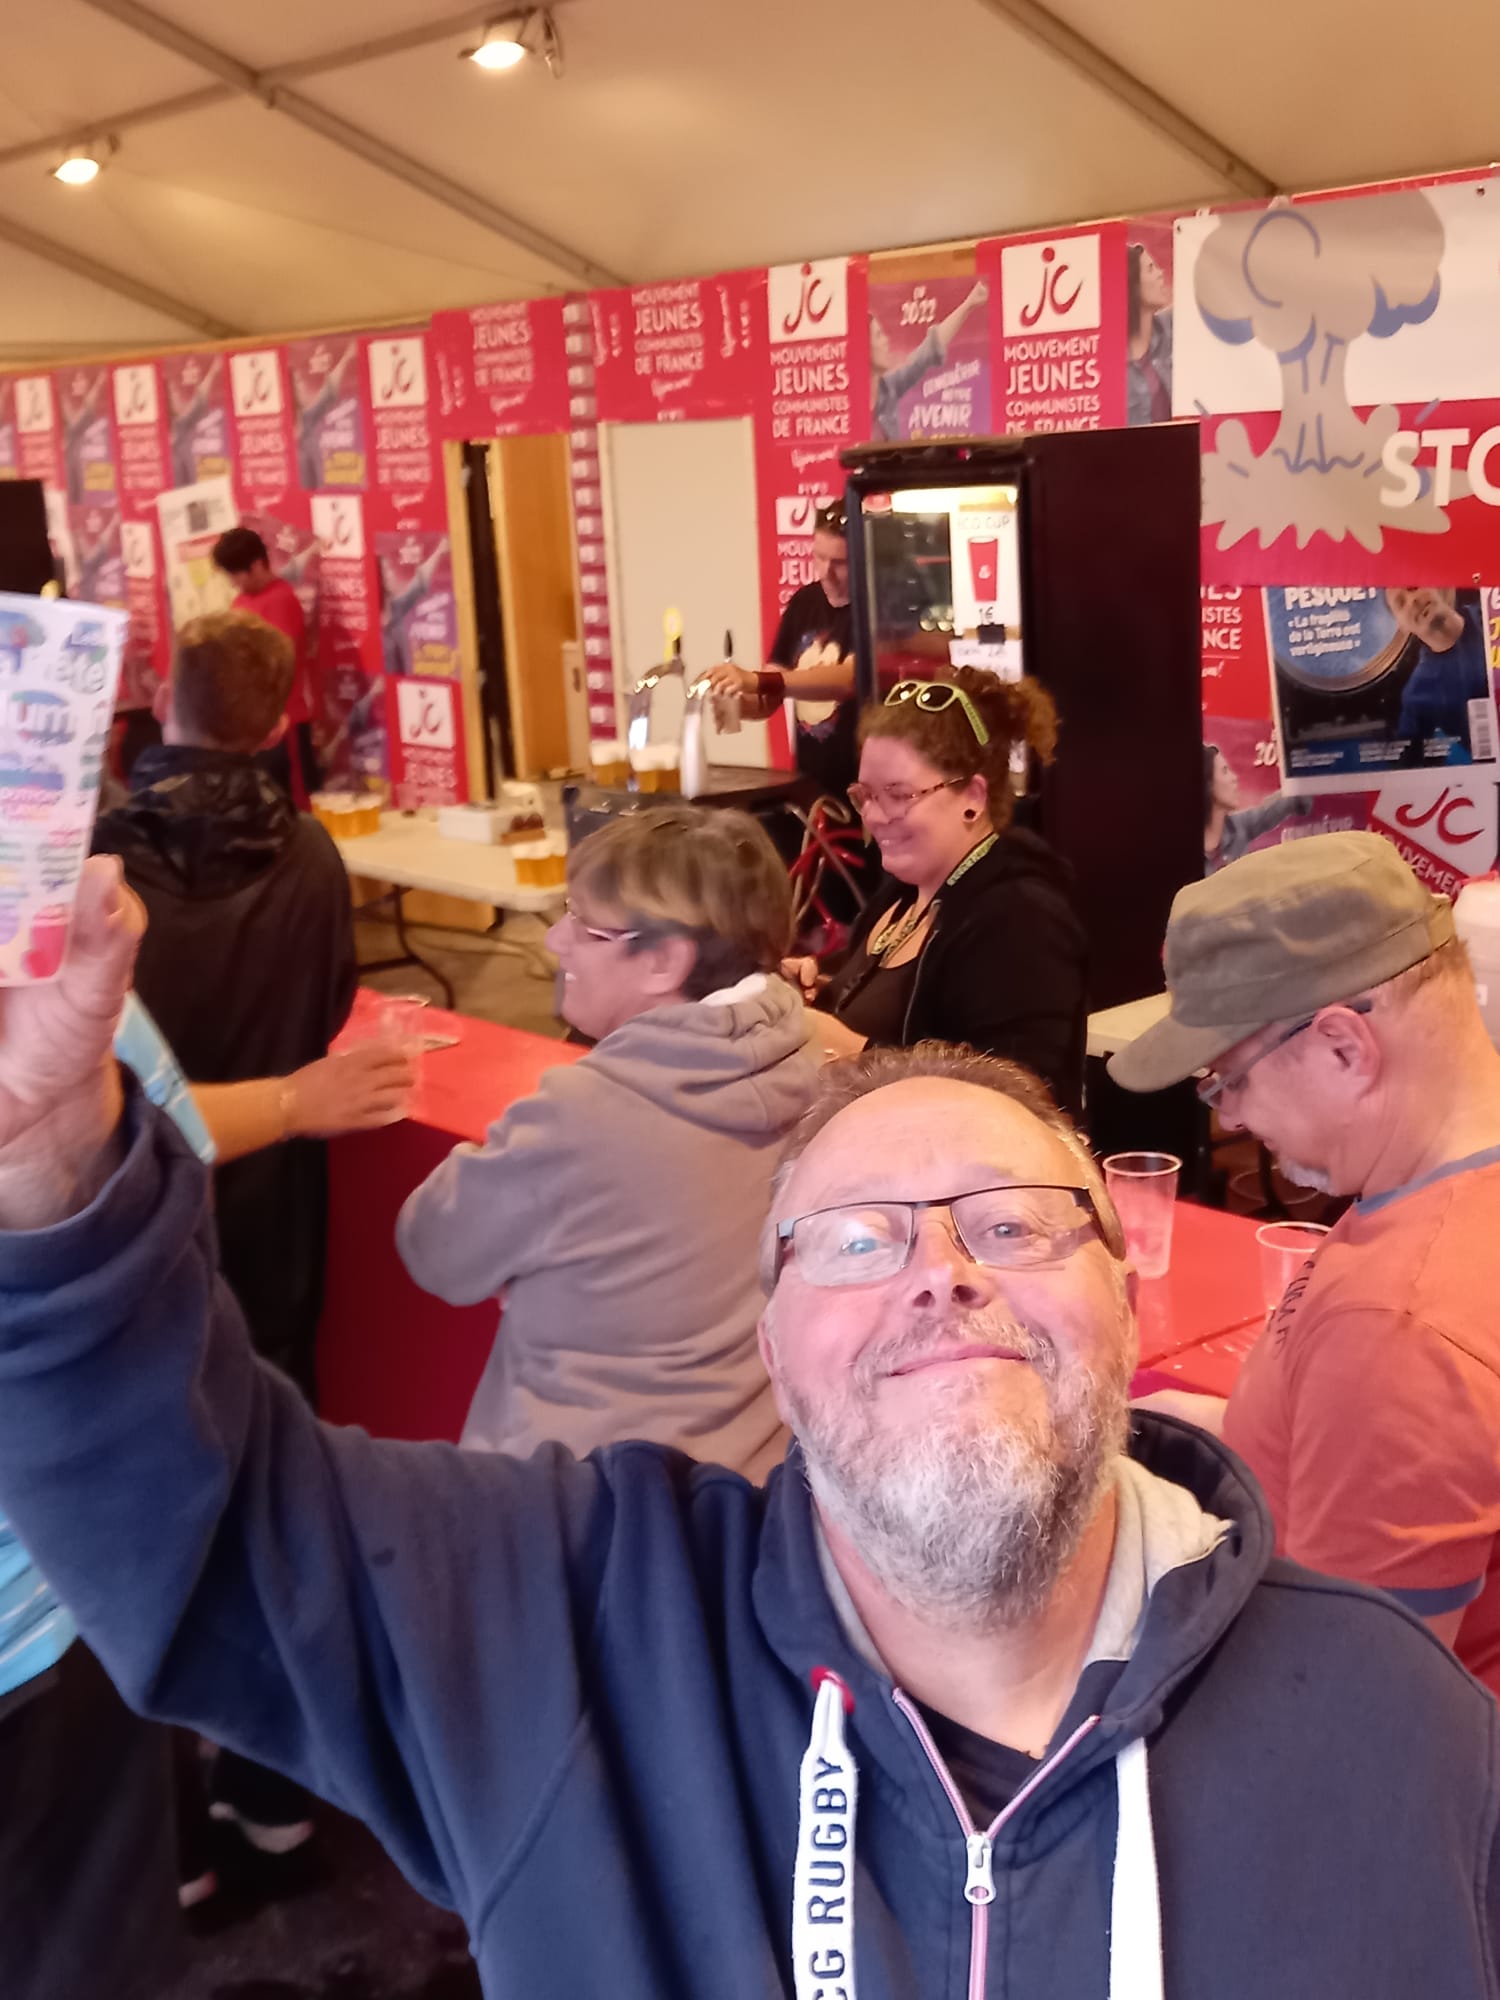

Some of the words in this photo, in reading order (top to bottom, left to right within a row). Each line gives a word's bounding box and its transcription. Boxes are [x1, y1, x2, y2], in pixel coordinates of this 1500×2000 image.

[634, 302, 704, 335] JEUNES
[770, 341, 848, 365] MOUVEMENT
[1004, 335, 1101, 362] MOUVEMENT
[772, 363, 849, 396] JEUNES
[1006, 359, 1101, 396] JEUNES
[908, 404, 972, 428] AVENIR
[1006, 395, 1100, 416] COMMUNISTES
[773, 418, 791, 438] DE
[796, 414, 849, 436] FRANCE
[1202, 627, 1242, 650] NCE
[807, 1756, 848, 1925] RUGBY
